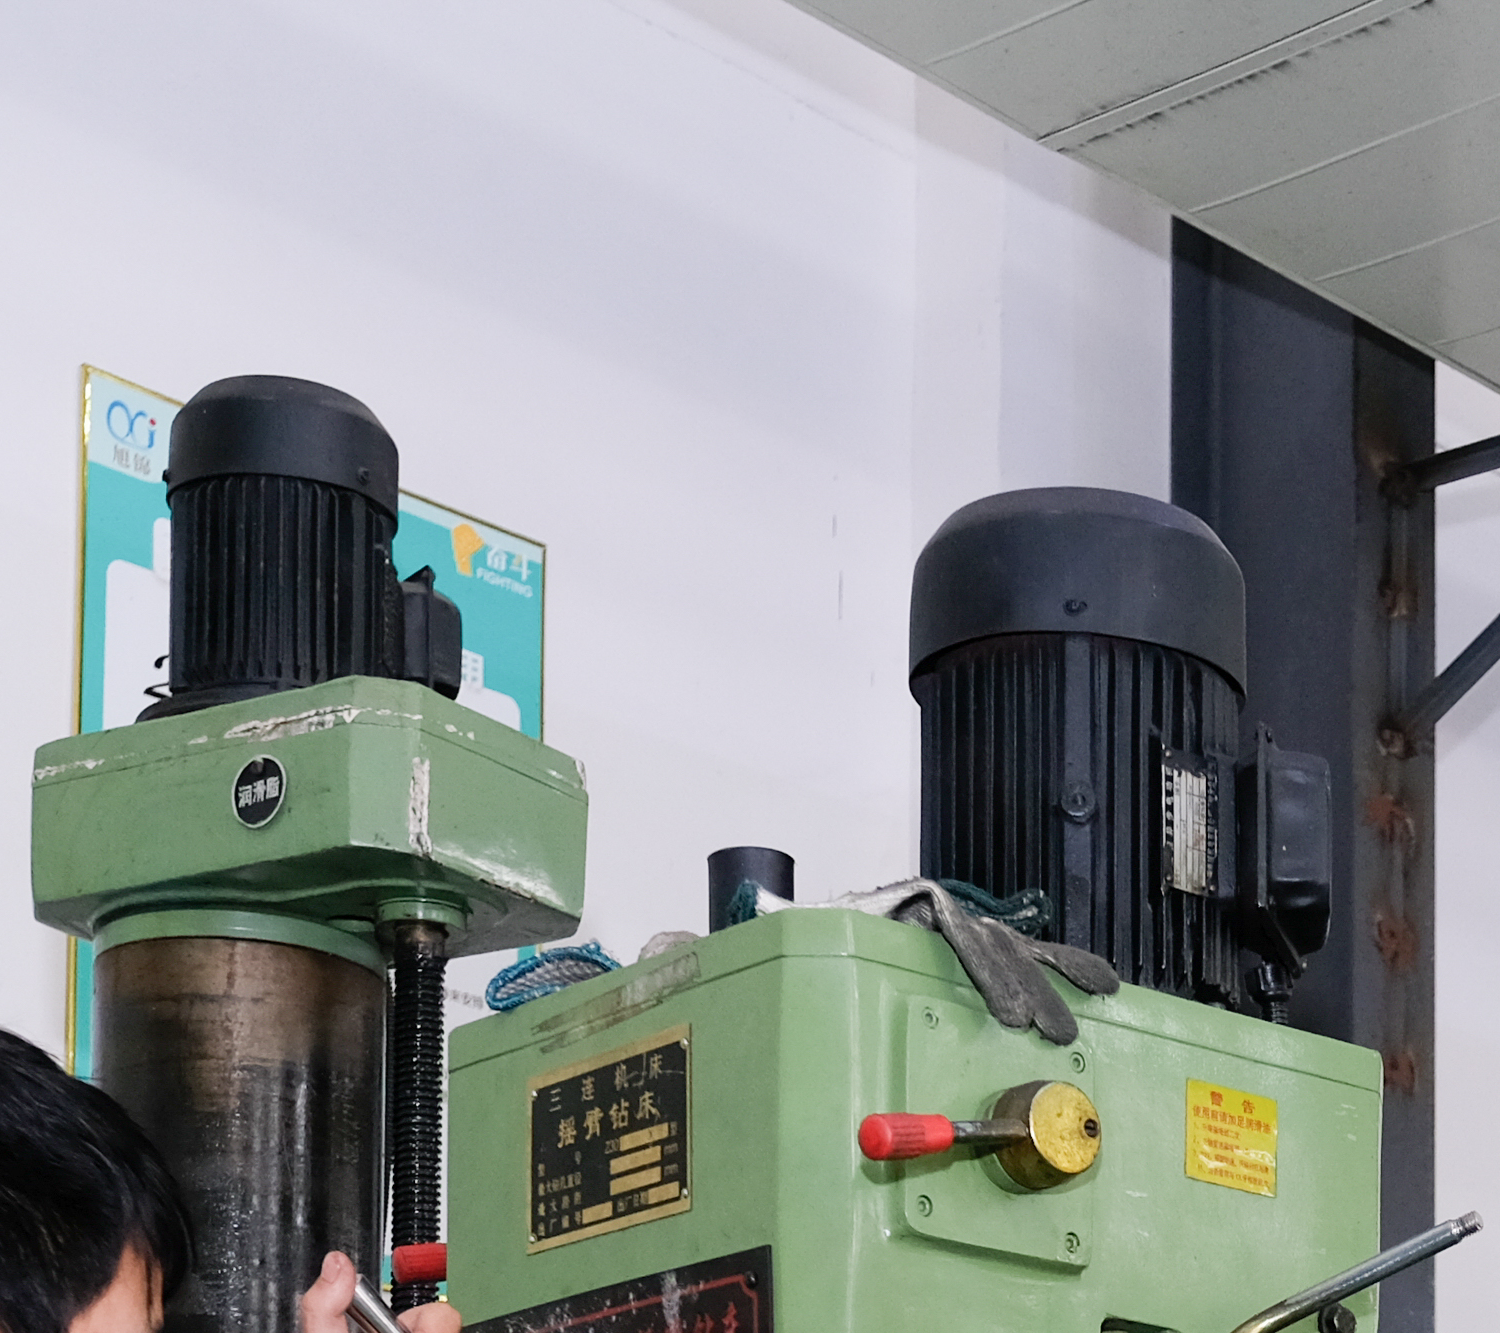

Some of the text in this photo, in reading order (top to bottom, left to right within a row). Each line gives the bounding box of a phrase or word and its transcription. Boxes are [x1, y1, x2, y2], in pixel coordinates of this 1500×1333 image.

[476, 567, 534, 598] FIGHTING
[549, 1054, 664, 1112] 三连机床
[1210, 1091, 1255, 1114] 警告
[557, 1091, 661, 1148] 摇臂钻床
